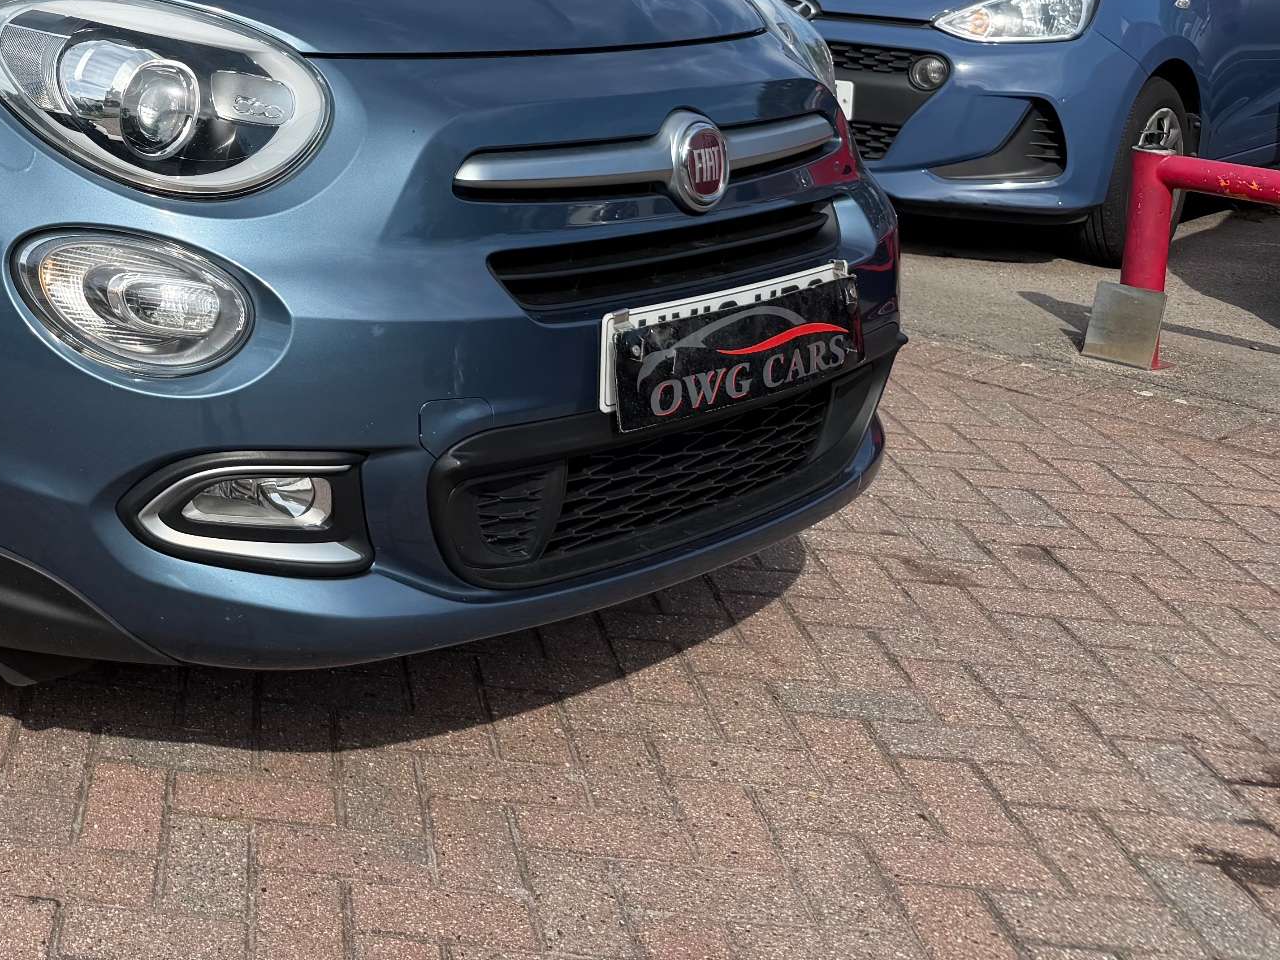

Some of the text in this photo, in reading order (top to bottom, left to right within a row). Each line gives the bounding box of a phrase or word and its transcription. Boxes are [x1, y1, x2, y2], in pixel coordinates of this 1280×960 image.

[692, 146, 720, 184] FIAT
[650, 334, 847, 417] OWG CARS
